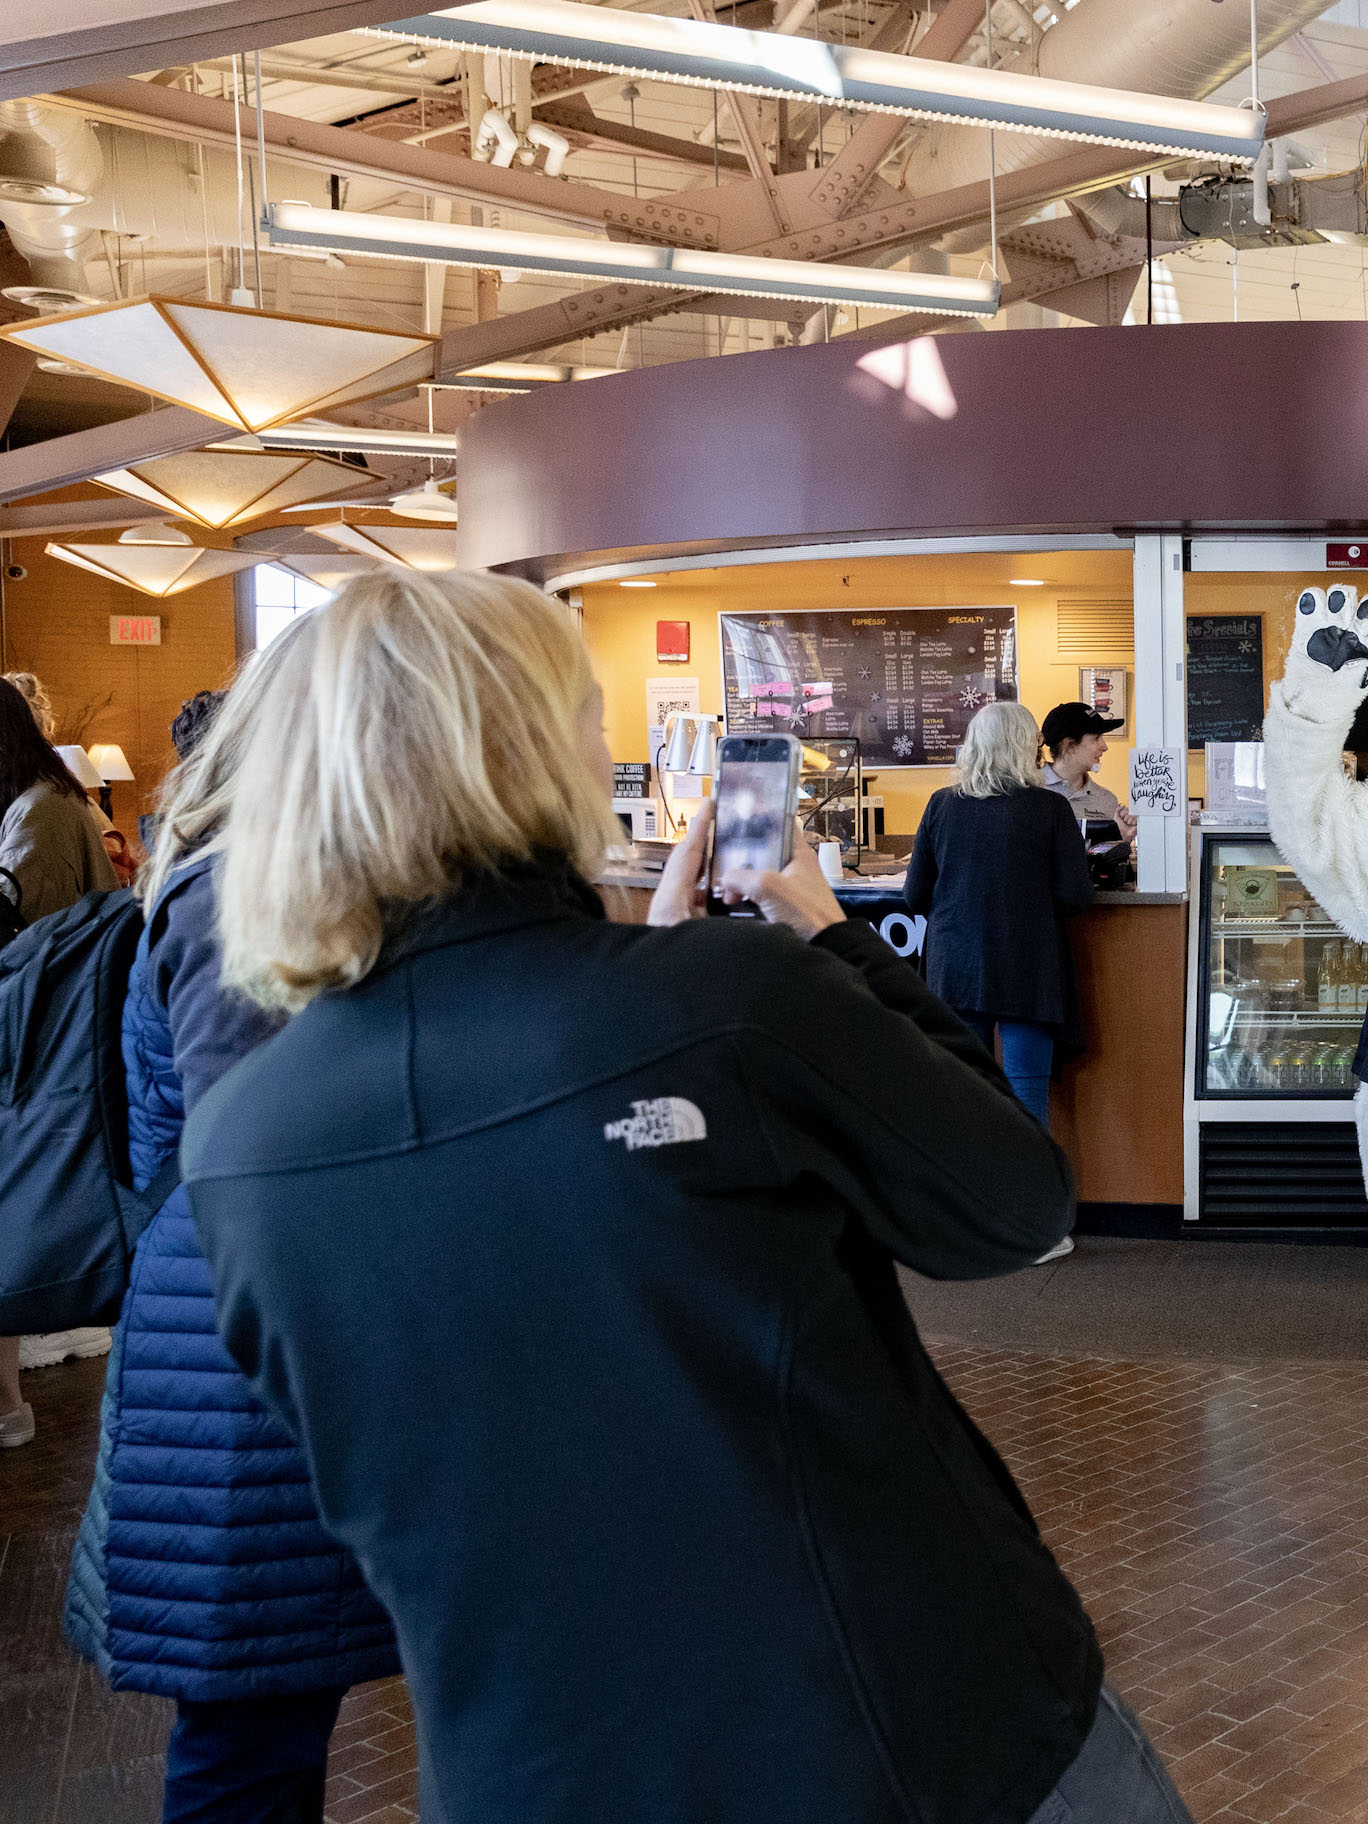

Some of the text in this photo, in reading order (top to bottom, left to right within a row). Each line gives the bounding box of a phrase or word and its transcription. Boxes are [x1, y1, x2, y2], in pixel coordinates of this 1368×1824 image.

[760, 620, 785, 628] COFFEE
[852, 618, 887, 626] ESPRESSO
[119, 619, 153, 641] EXIT
[1204, 620, 1257, 638] Specials
[1160, 751, 1174, 765] is
[626, 764, 644, 774] COFFEE
